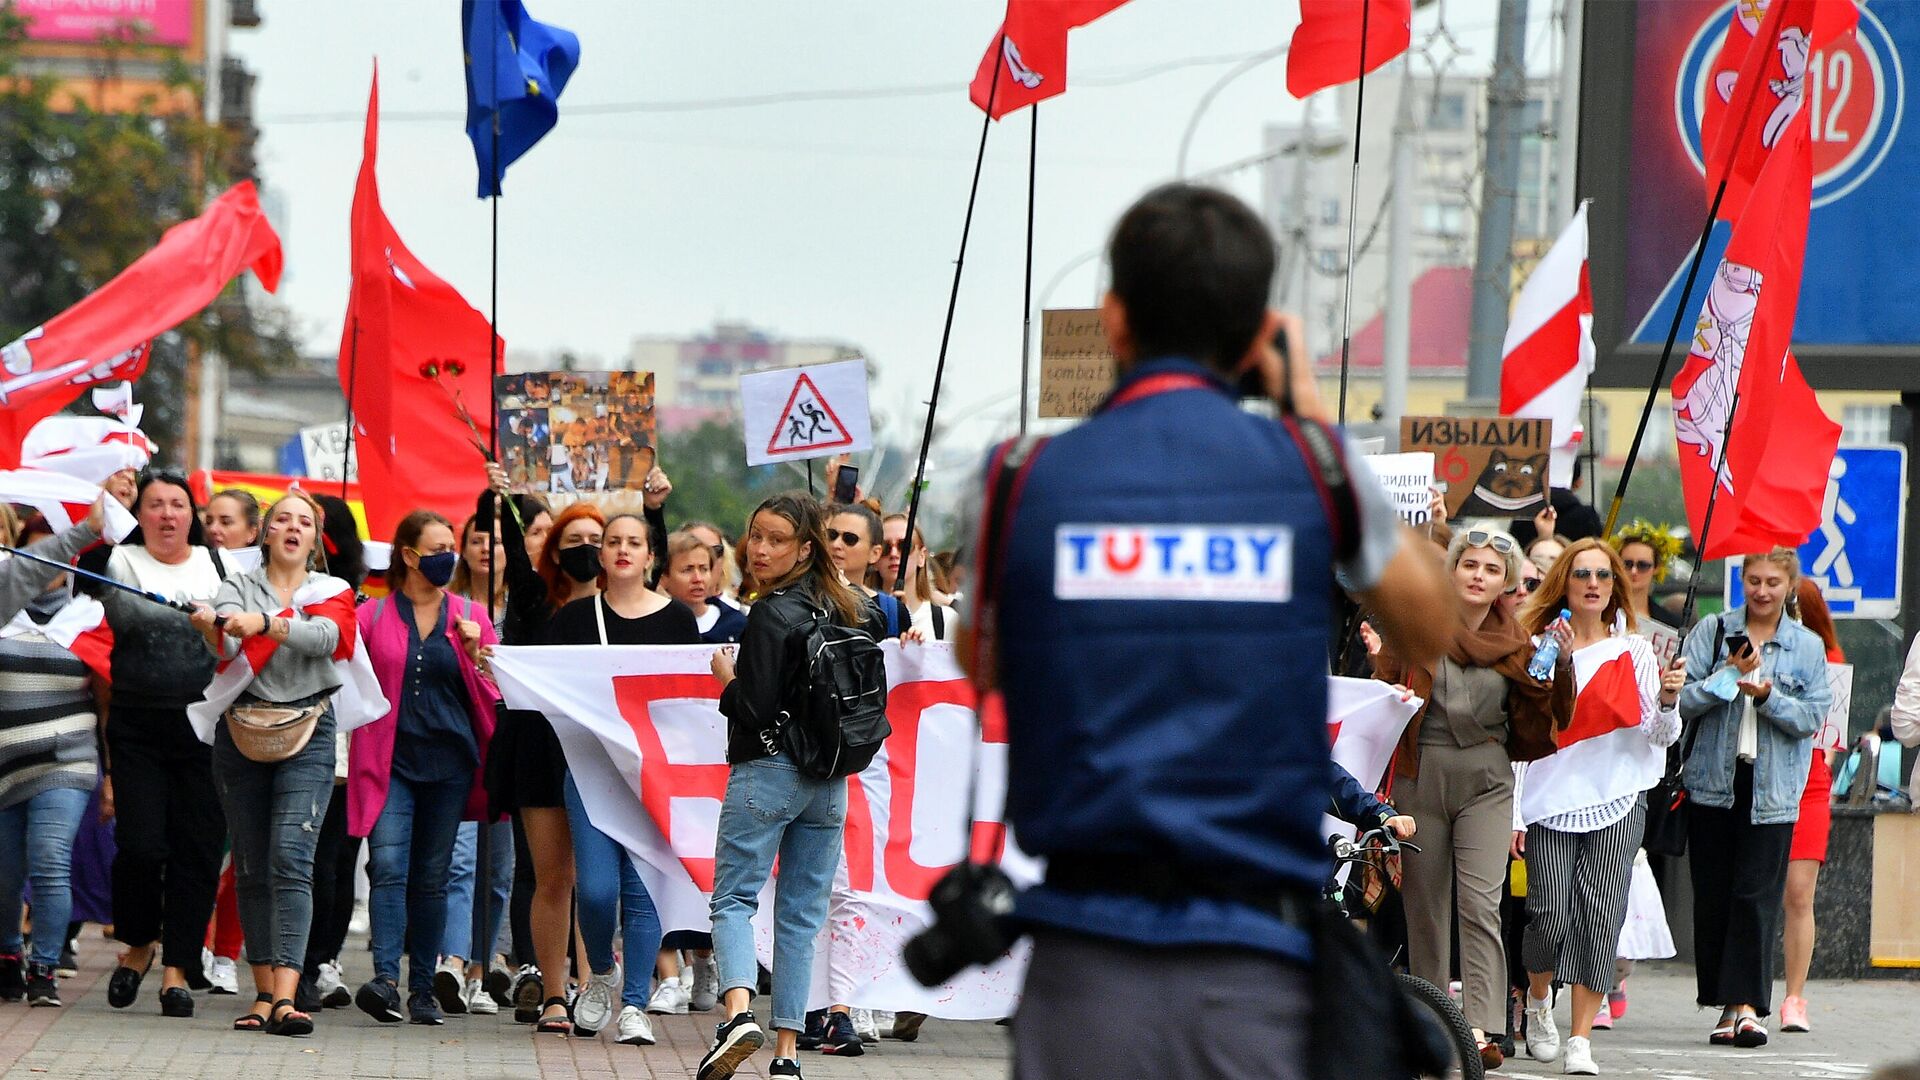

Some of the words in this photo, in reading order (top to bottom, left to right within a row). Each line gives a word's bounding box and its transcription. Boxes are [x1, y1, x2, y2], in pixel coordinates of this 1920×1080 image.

[1411, 420, 1543, 449] ИЗЫДИ!
[1378, 474, 1428, 488] ЗИДЕНТ
[1386, 492, 1428, 504] ЛАСТИ
[1068, 534, 1277, 576] TUT.BY
